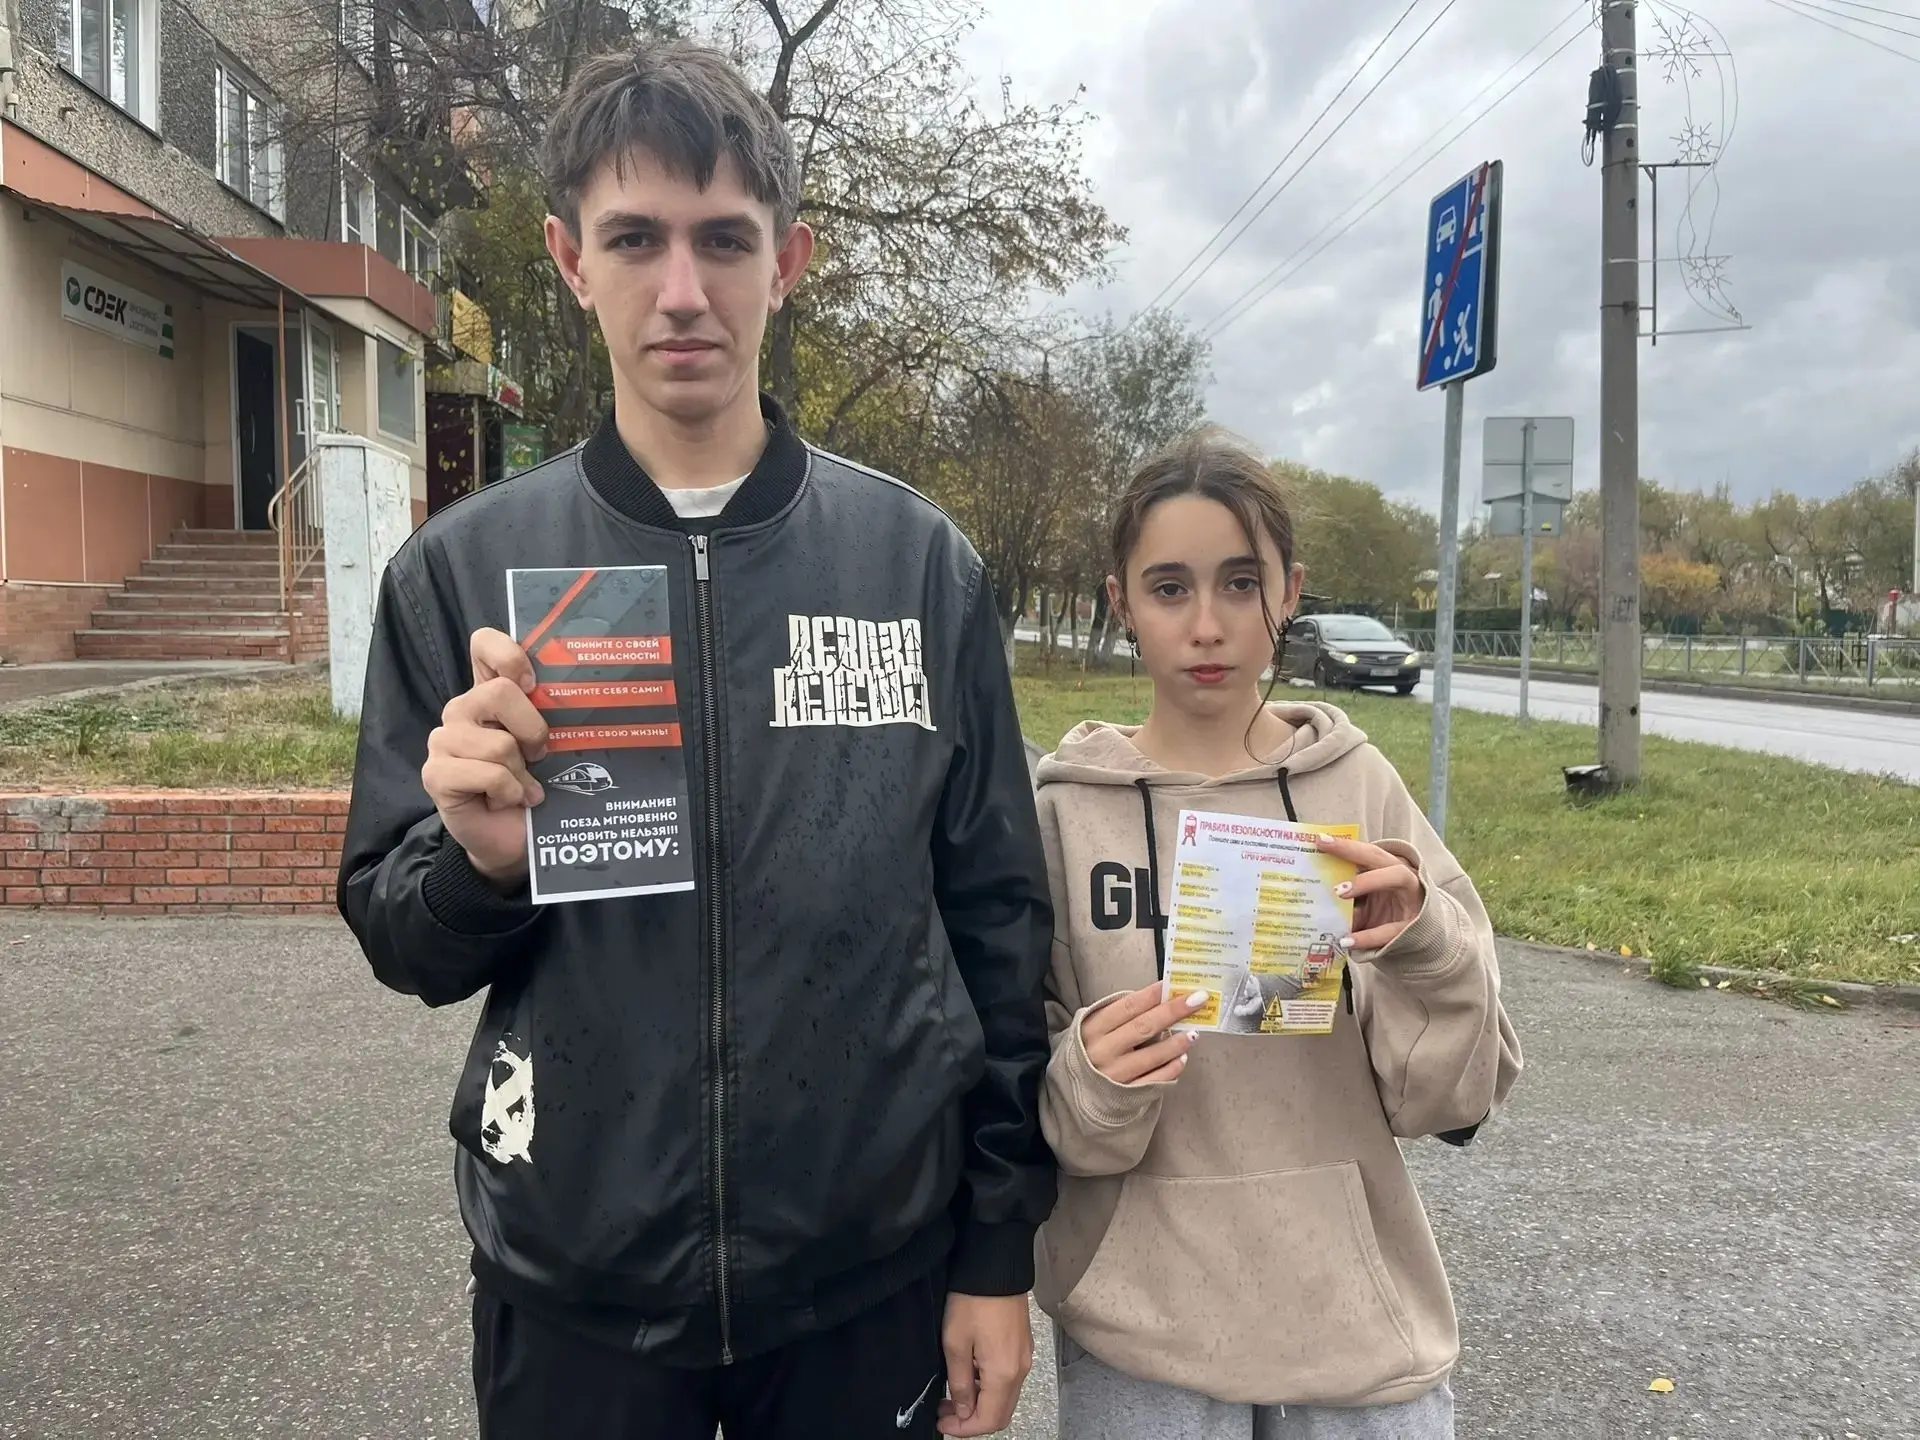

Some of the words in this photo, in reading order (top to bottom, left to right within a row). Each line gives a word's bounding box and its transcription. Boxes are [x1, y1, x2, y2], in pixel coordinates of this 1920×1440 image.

[84, 285, 128, 326] CDEK
[567, 640, 613, 649] ПОМНИТЕ
[625, 638, 659, 648] СВОЕЙ
[577, 652, 660, 661] БЕЗОПАСНОСТИ!
[549, 688, 600, 697] ЗАЩИТИТЕ
[602, 687, 628, 695] СЕБЯ
[631, 686, 663, 694] САМИ!
[549, 730, 595, 740] БЕРЕГИТЕ
[597, 730, 628, 738] СВОЮ
[630, 729, 669, 737] ЖИЗНЬ!
[605, 797, 677, 812] ВНИМАНИЕ!
[603, 811, 678, 826] МГНОВЕННО
[536, 832, 618, 845] ОСТАНОВИТЬ
[621, 825, 679, 839] НЕЛЬЗЯ!!!
[1199, 820, 1230, 833] ПРАВИЛА
[1230, 824, 1282, 840] БЕЗОПАСНОСТИ
[539, 837, 679, 867] ПОЭТОМУ:
